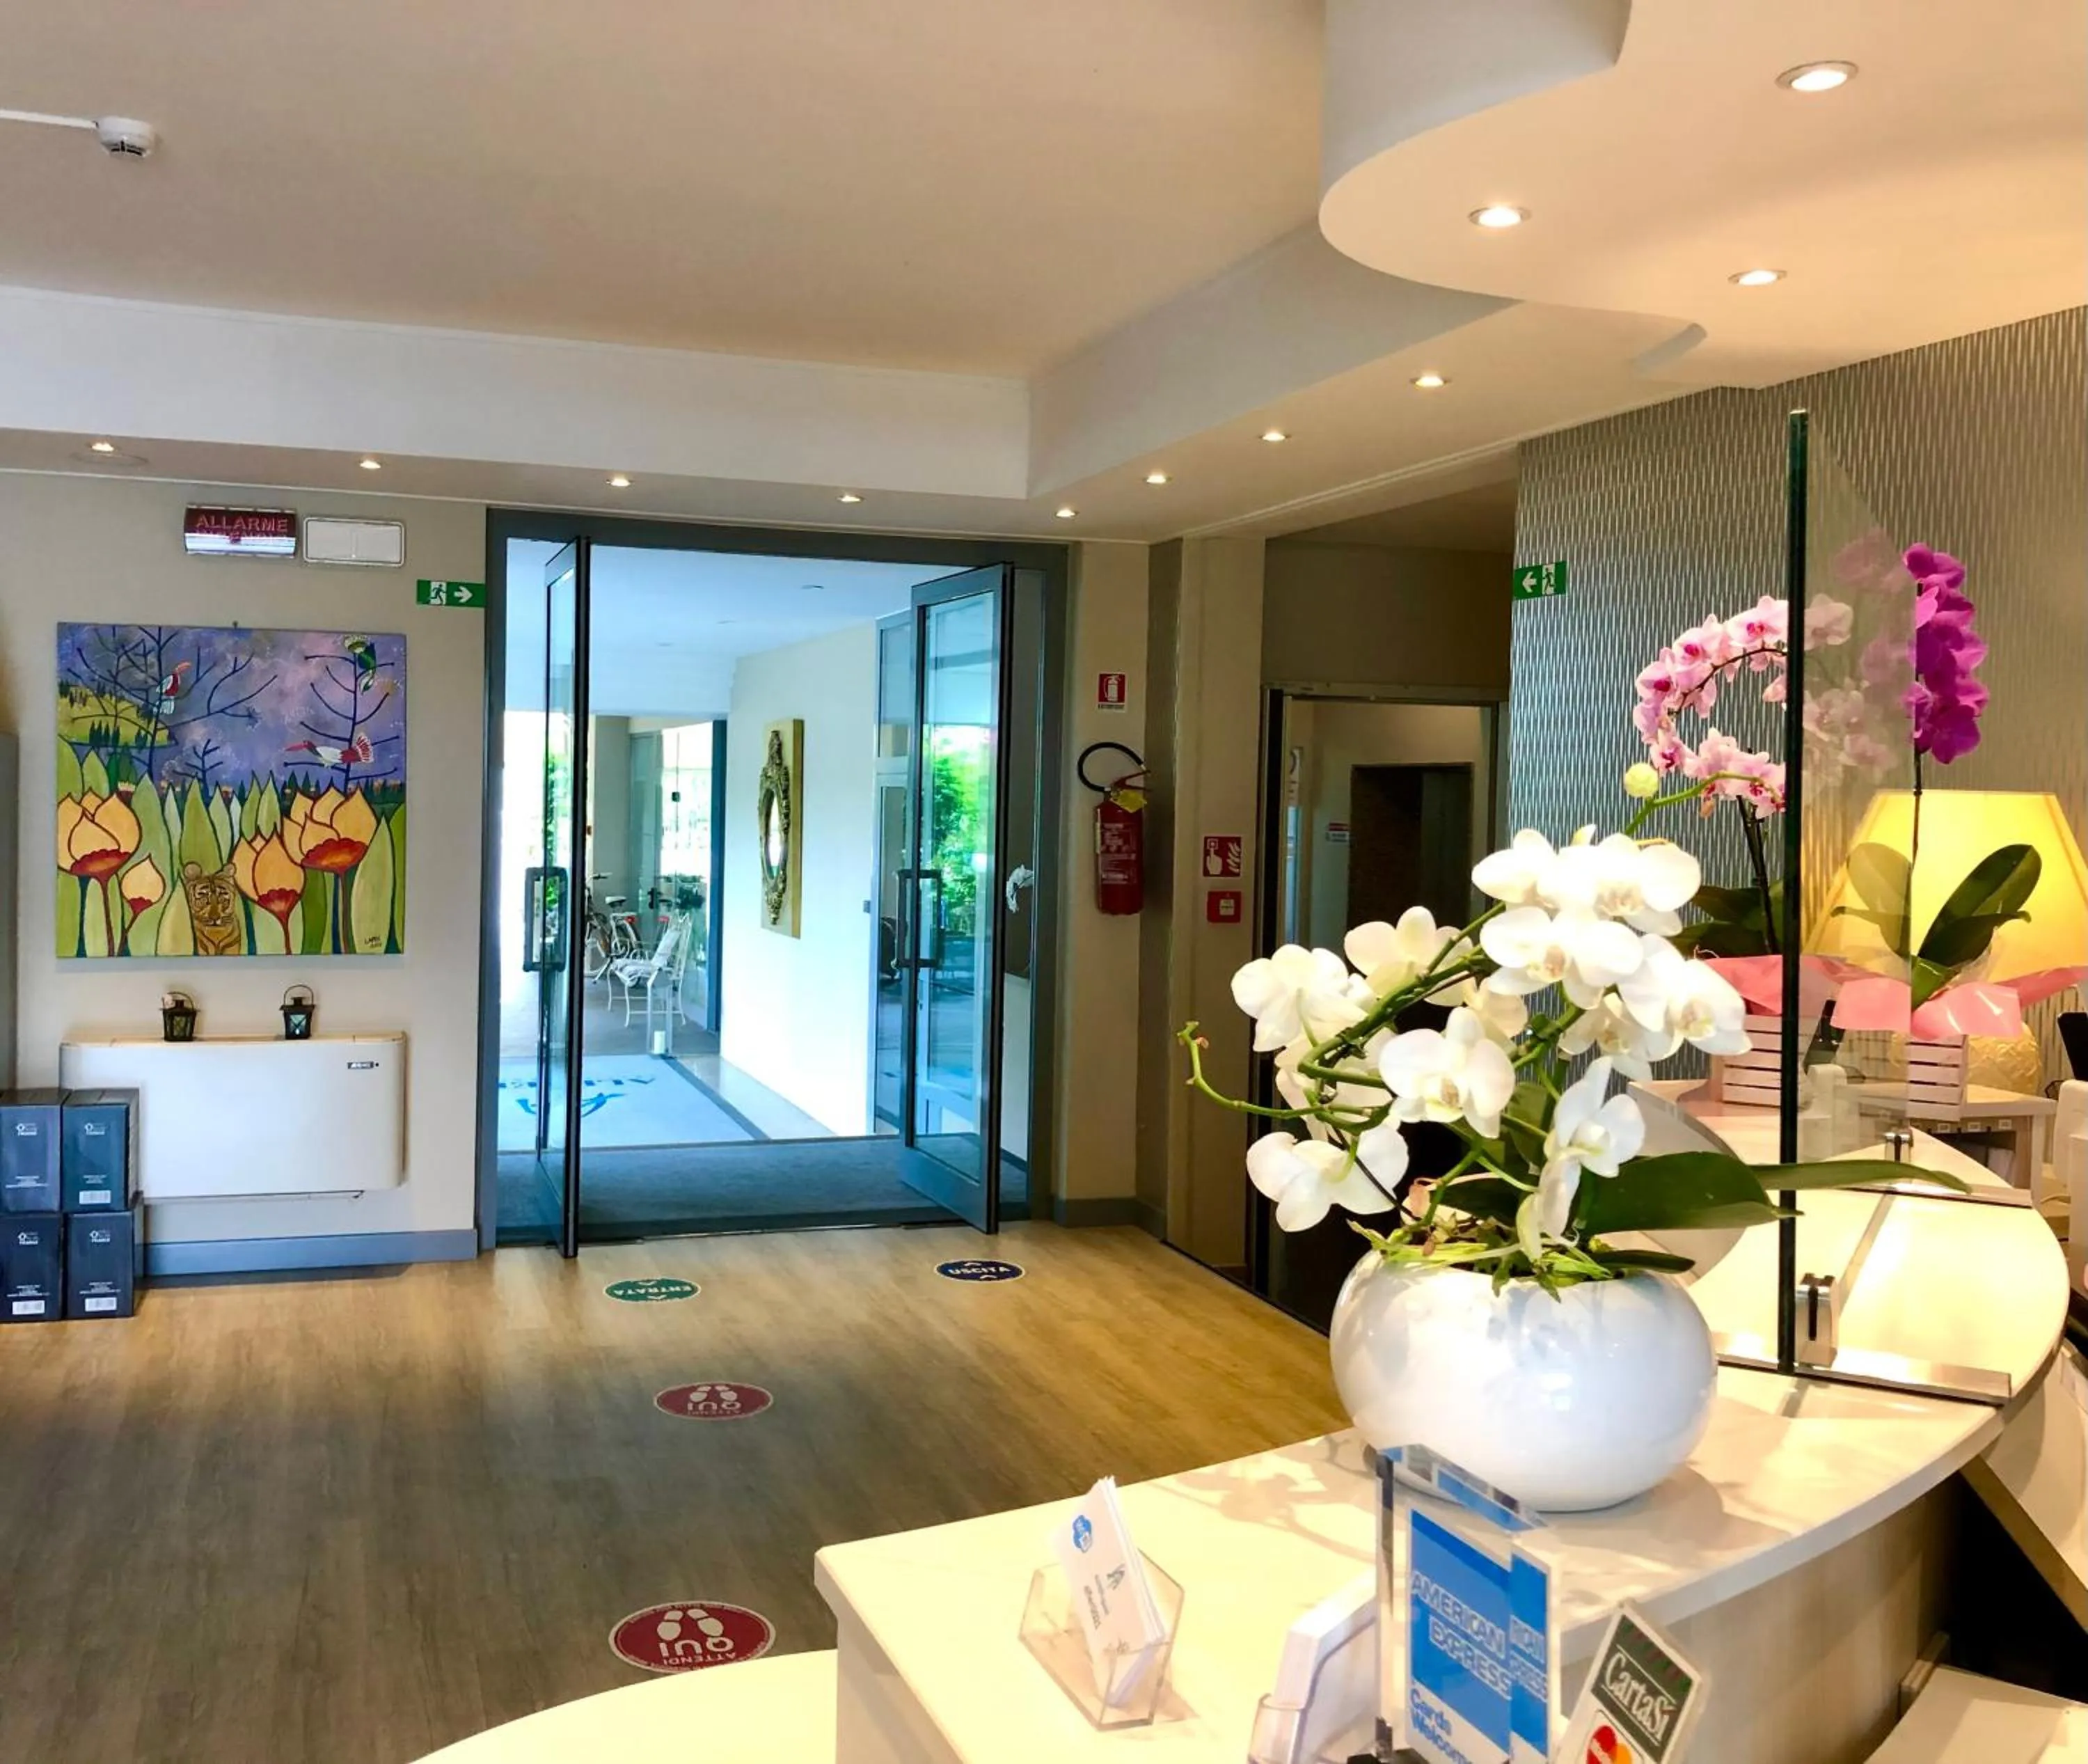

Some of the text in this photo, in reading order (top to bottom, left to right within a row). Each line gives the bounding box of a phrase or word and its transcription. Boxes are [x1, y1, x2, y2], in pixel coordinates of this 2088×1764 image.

[196, 514, 289, 533] ALLARME
[947, 1266, 1011, 1275] USCITA
[613, 1285, 693, 1296] ENTRATA
[687, 1401, 742, 1411] QUI
[1411, 1569, 1505, 1660] AMERICAN
[658, 1636, 734, 1657] QUI
[663, 1652, 736, 1666] ATTENDI
[1429, 1614, 1512, 1701] EXPRESS
[1410, 1688, 1452, 1736] Cards
[1411, 1706, 1473, 1764] Welcom
